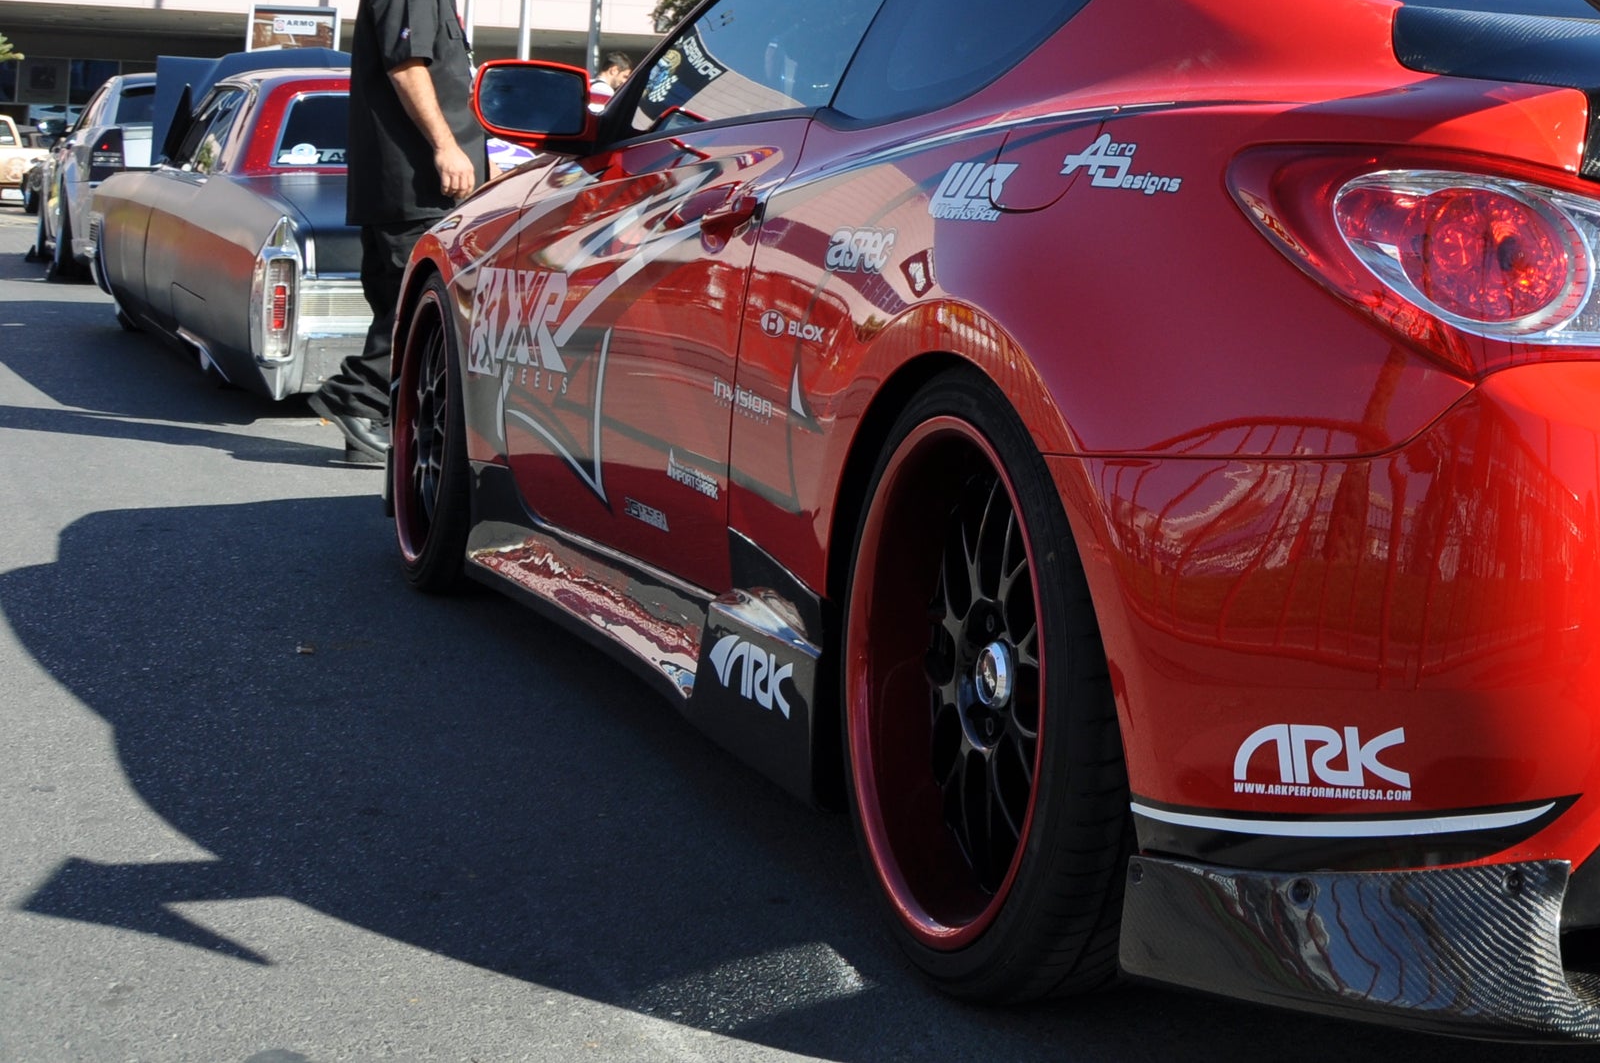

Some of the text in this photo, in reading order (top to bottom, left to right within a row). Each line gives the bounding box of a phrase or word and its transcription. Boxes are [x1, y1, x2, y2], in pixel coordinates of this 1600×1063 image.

[286, 19, 315, 27] ARMO
[1060, 133, 1137, 175] Aero
[1090, 155, 1182, 195] Designs
[787, 320, 825, 344] BLOX
[722, 639, 794, 720] ARK
[1233, 723, 1412, 789] ARK
[1233, 781, 1412, 802] WWW.ARKPERFORMANCEUSA.COM
